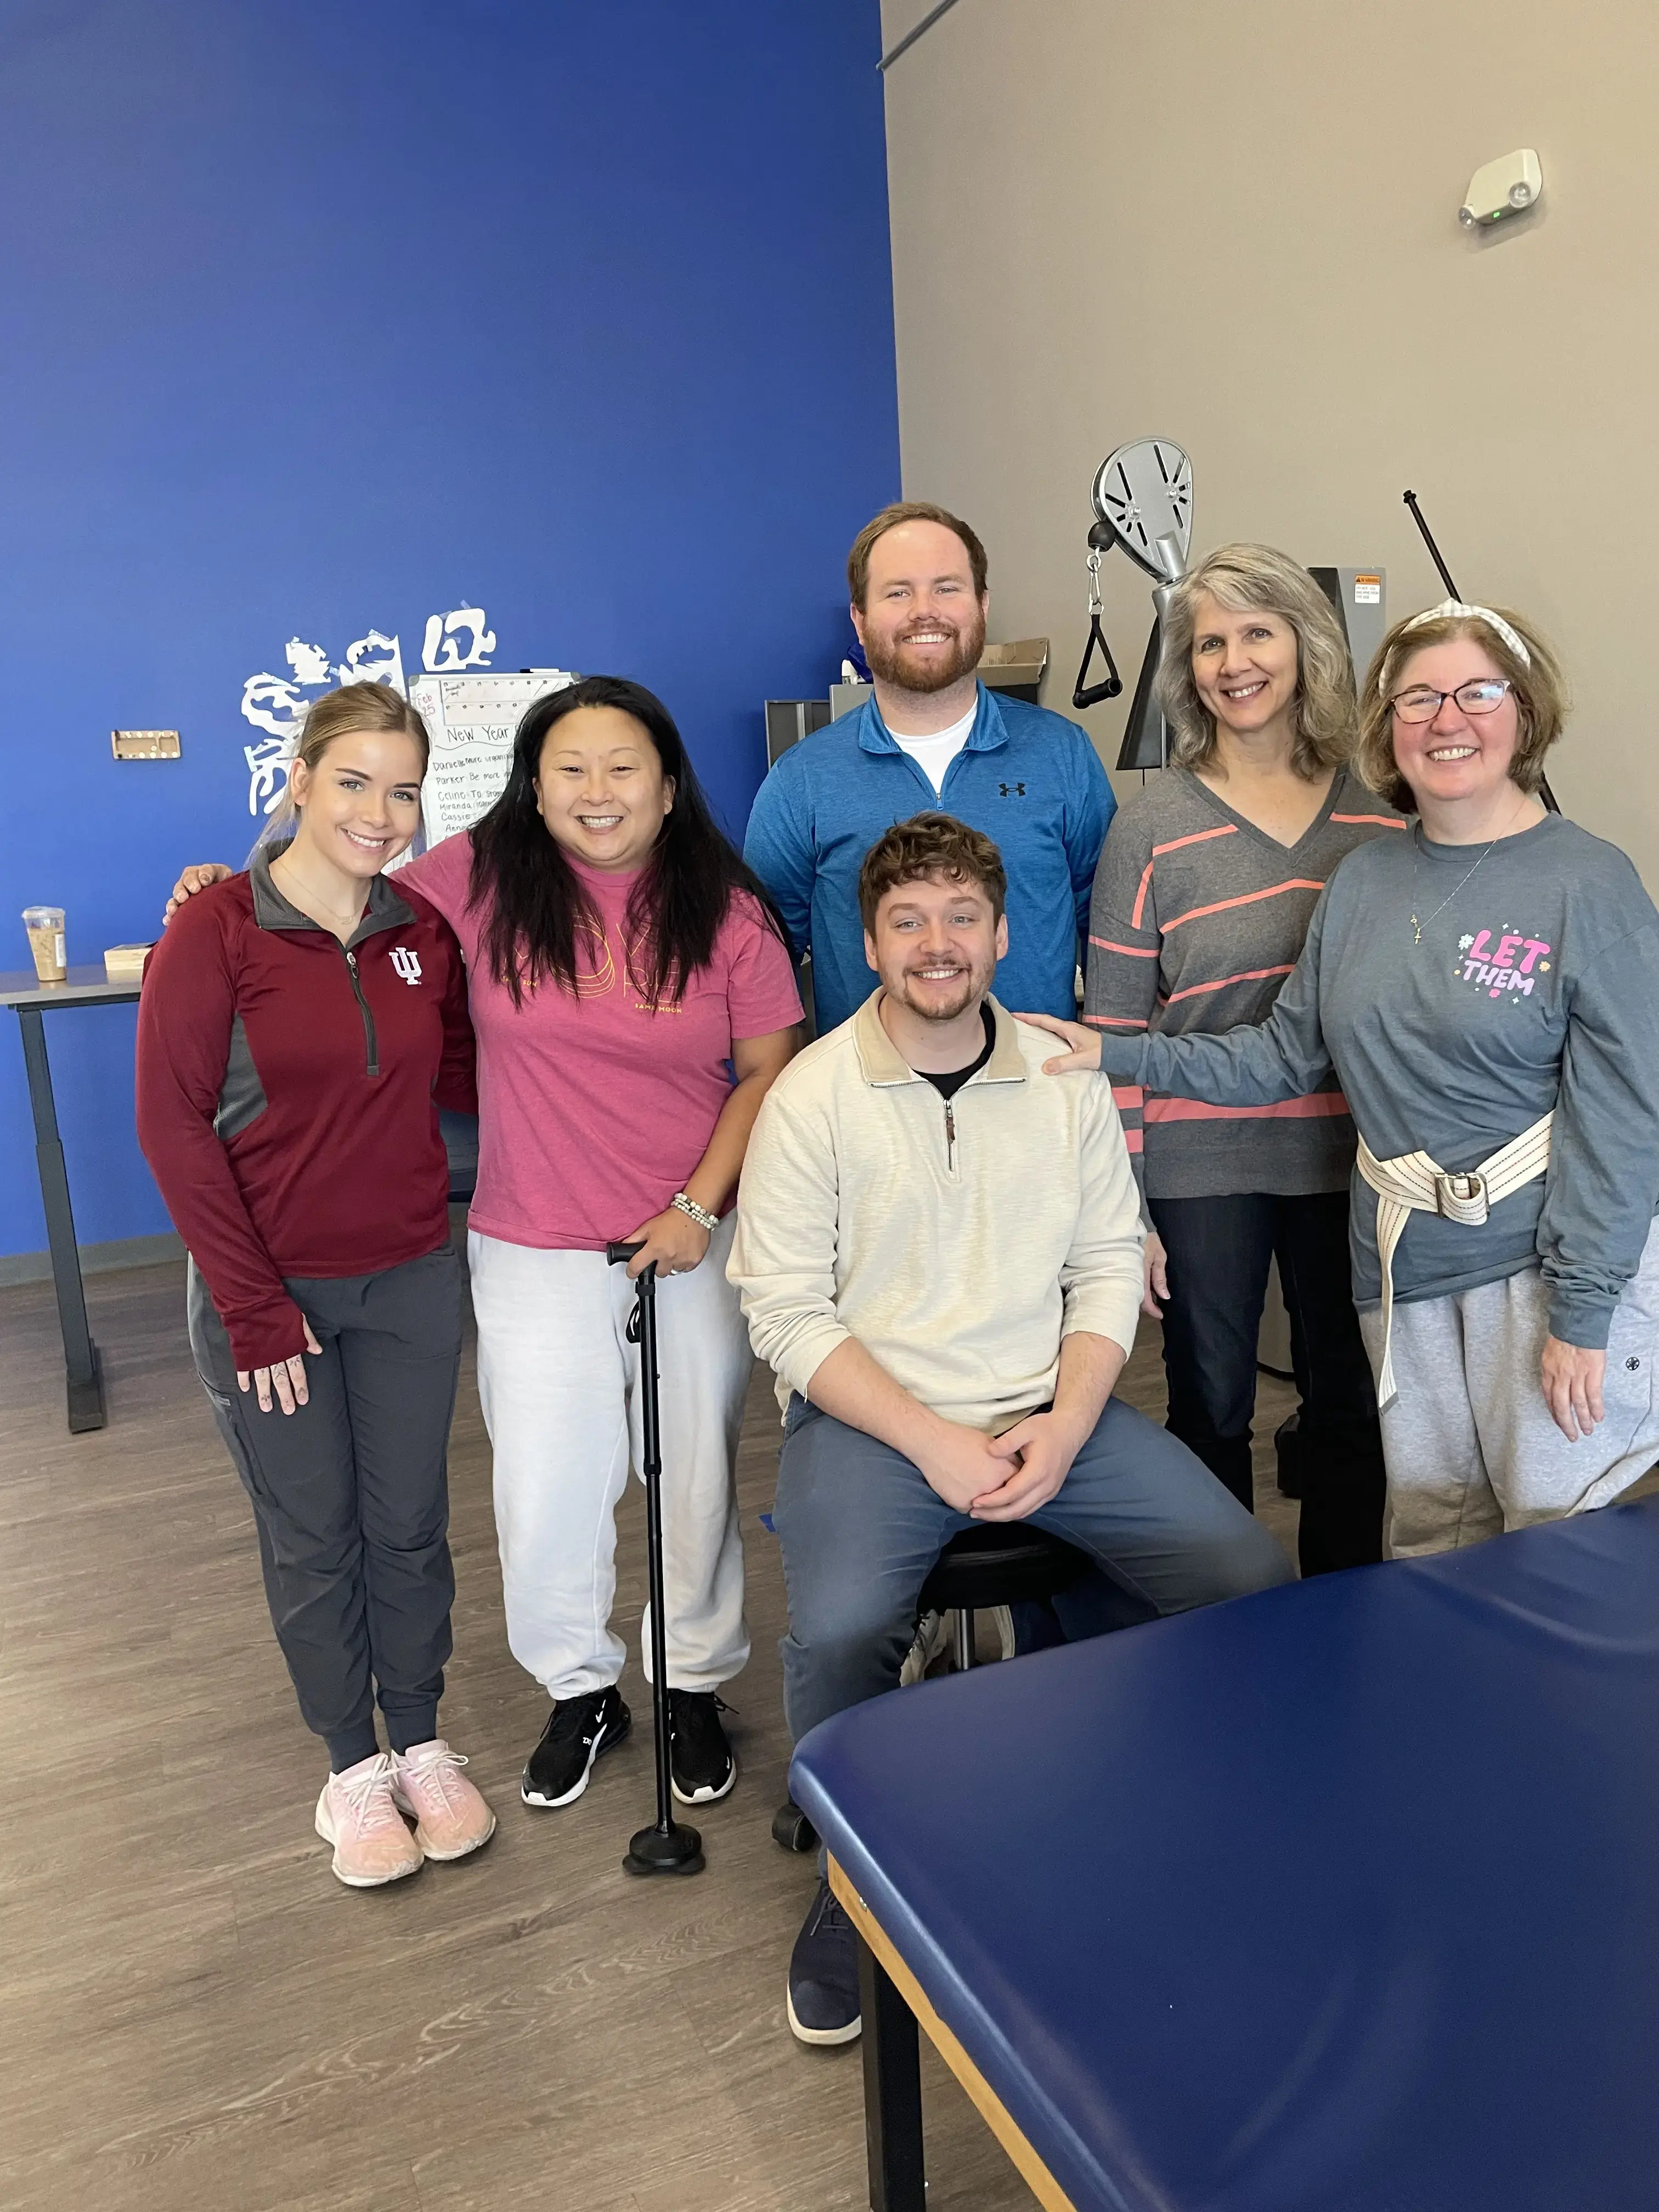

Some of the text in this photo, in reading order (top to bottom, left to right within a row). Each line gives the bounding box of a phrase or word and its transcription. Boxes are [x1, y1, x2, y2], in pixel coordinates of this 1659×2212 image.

[481, 725, 509, 741] Year
[469, 772, 480, 781] Be
[1469, 929, 1550, 974] LET
[1463, 960, 1535, 996] THEM
